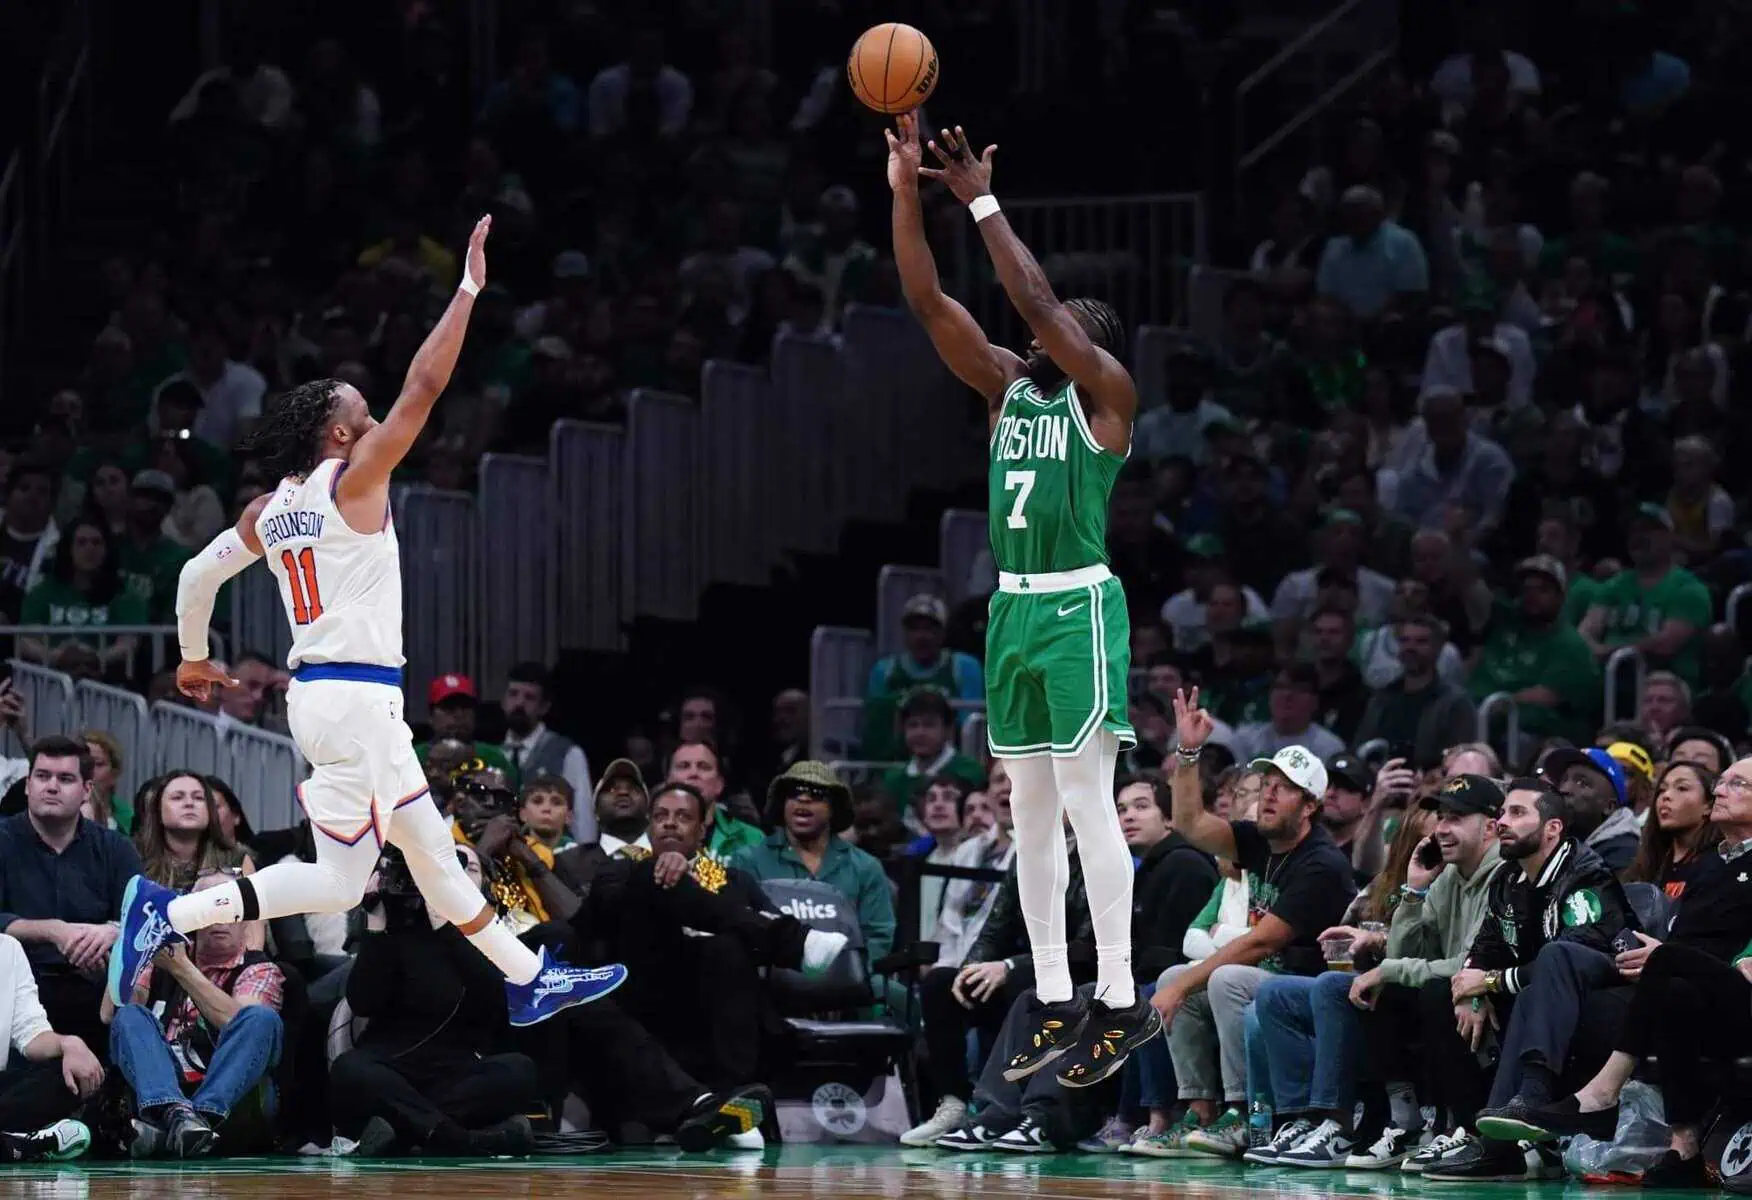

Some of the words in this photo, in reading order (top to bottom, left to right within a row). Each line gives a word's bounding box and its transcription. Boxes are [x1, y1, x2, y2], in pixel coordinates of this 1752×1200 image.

[1004, 470, 1036, 529] 7
[264, 511, 325, 548] BRUNSON
[281, 547, 324, 625] 11
[779, 898, 838, 920] eltics
